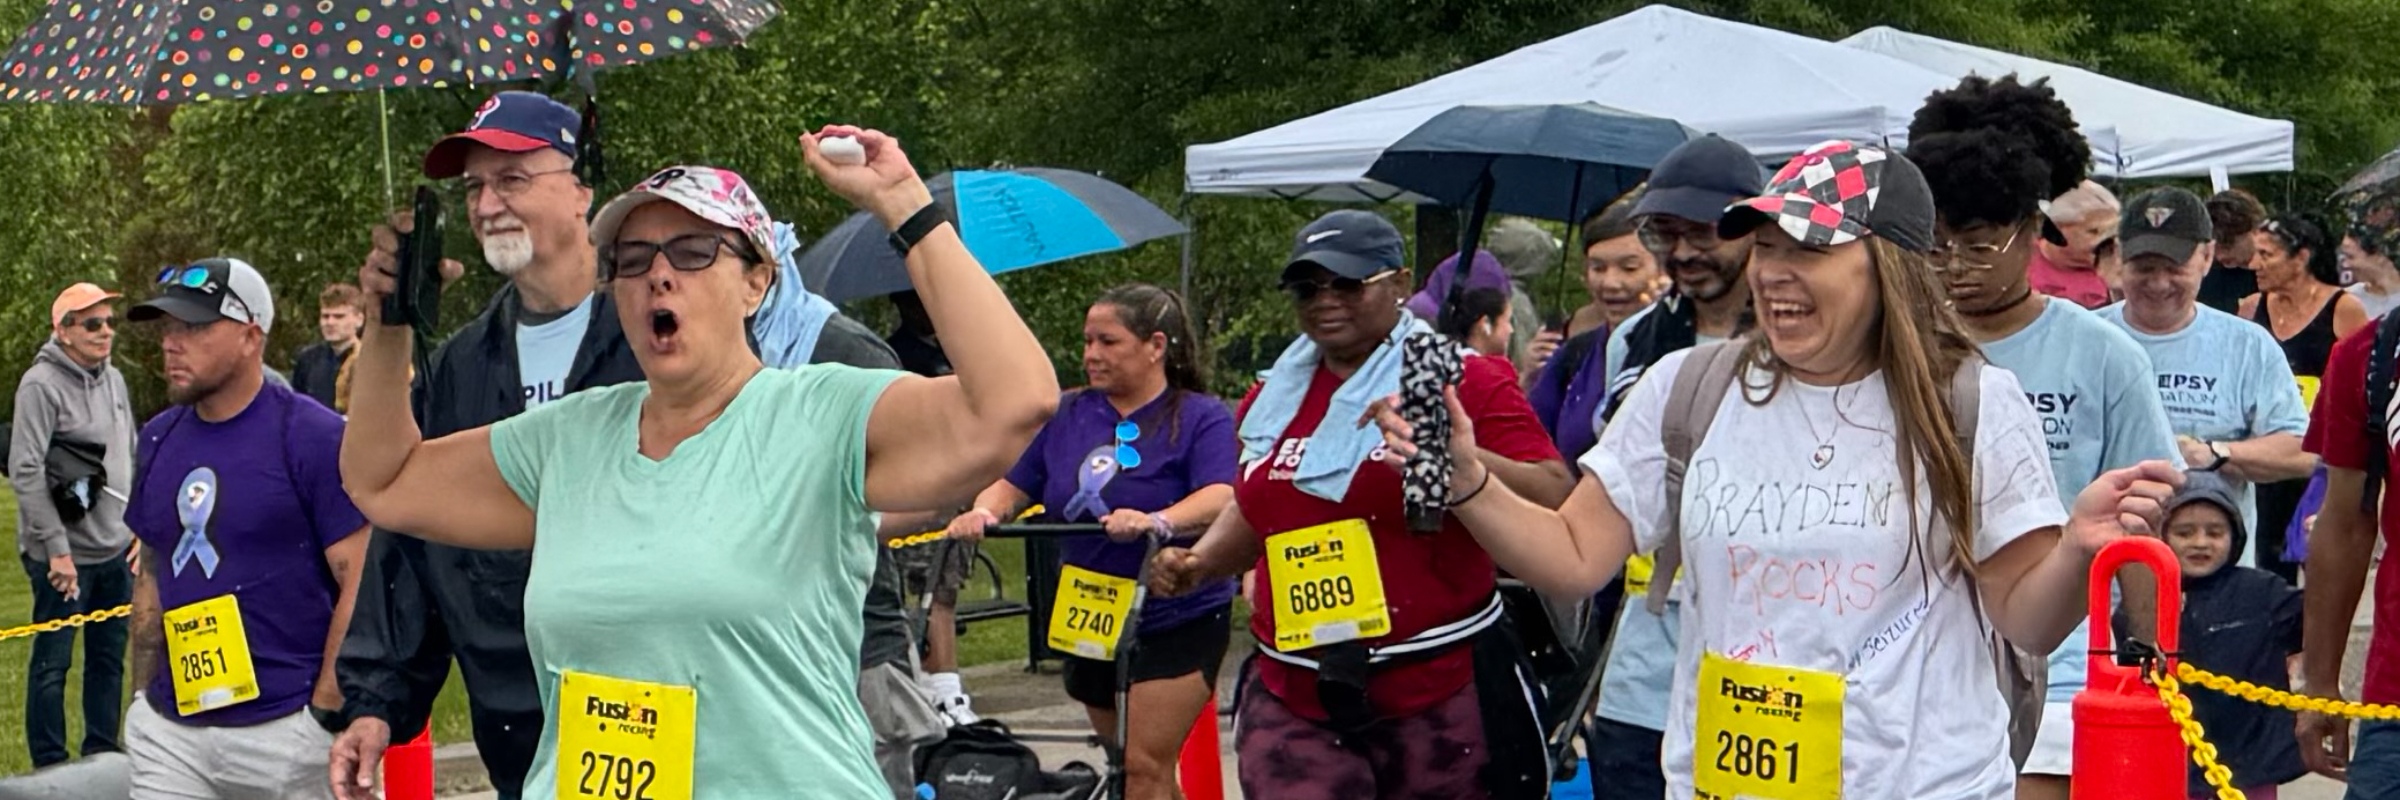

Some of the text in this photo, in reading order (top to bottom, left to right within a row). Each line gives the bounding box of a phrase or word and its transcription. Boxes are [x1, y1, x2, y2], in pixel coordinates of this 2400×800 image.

[1687, 456, 1892, 542] BRAYDEN
[1290, 576, 1355, 615] 6889
[1727, 545, 1877, 616] ROCKS
[1066, 607, 1115, 637] 2740
[181, 647, 227, 683] 2851
[586, 696, 658, 725] Fusion
[1721, 677, 1803, 709] Fusion
[579, 751, 656, 800] 2792
[1716, 730, 1799, 784] 2861
